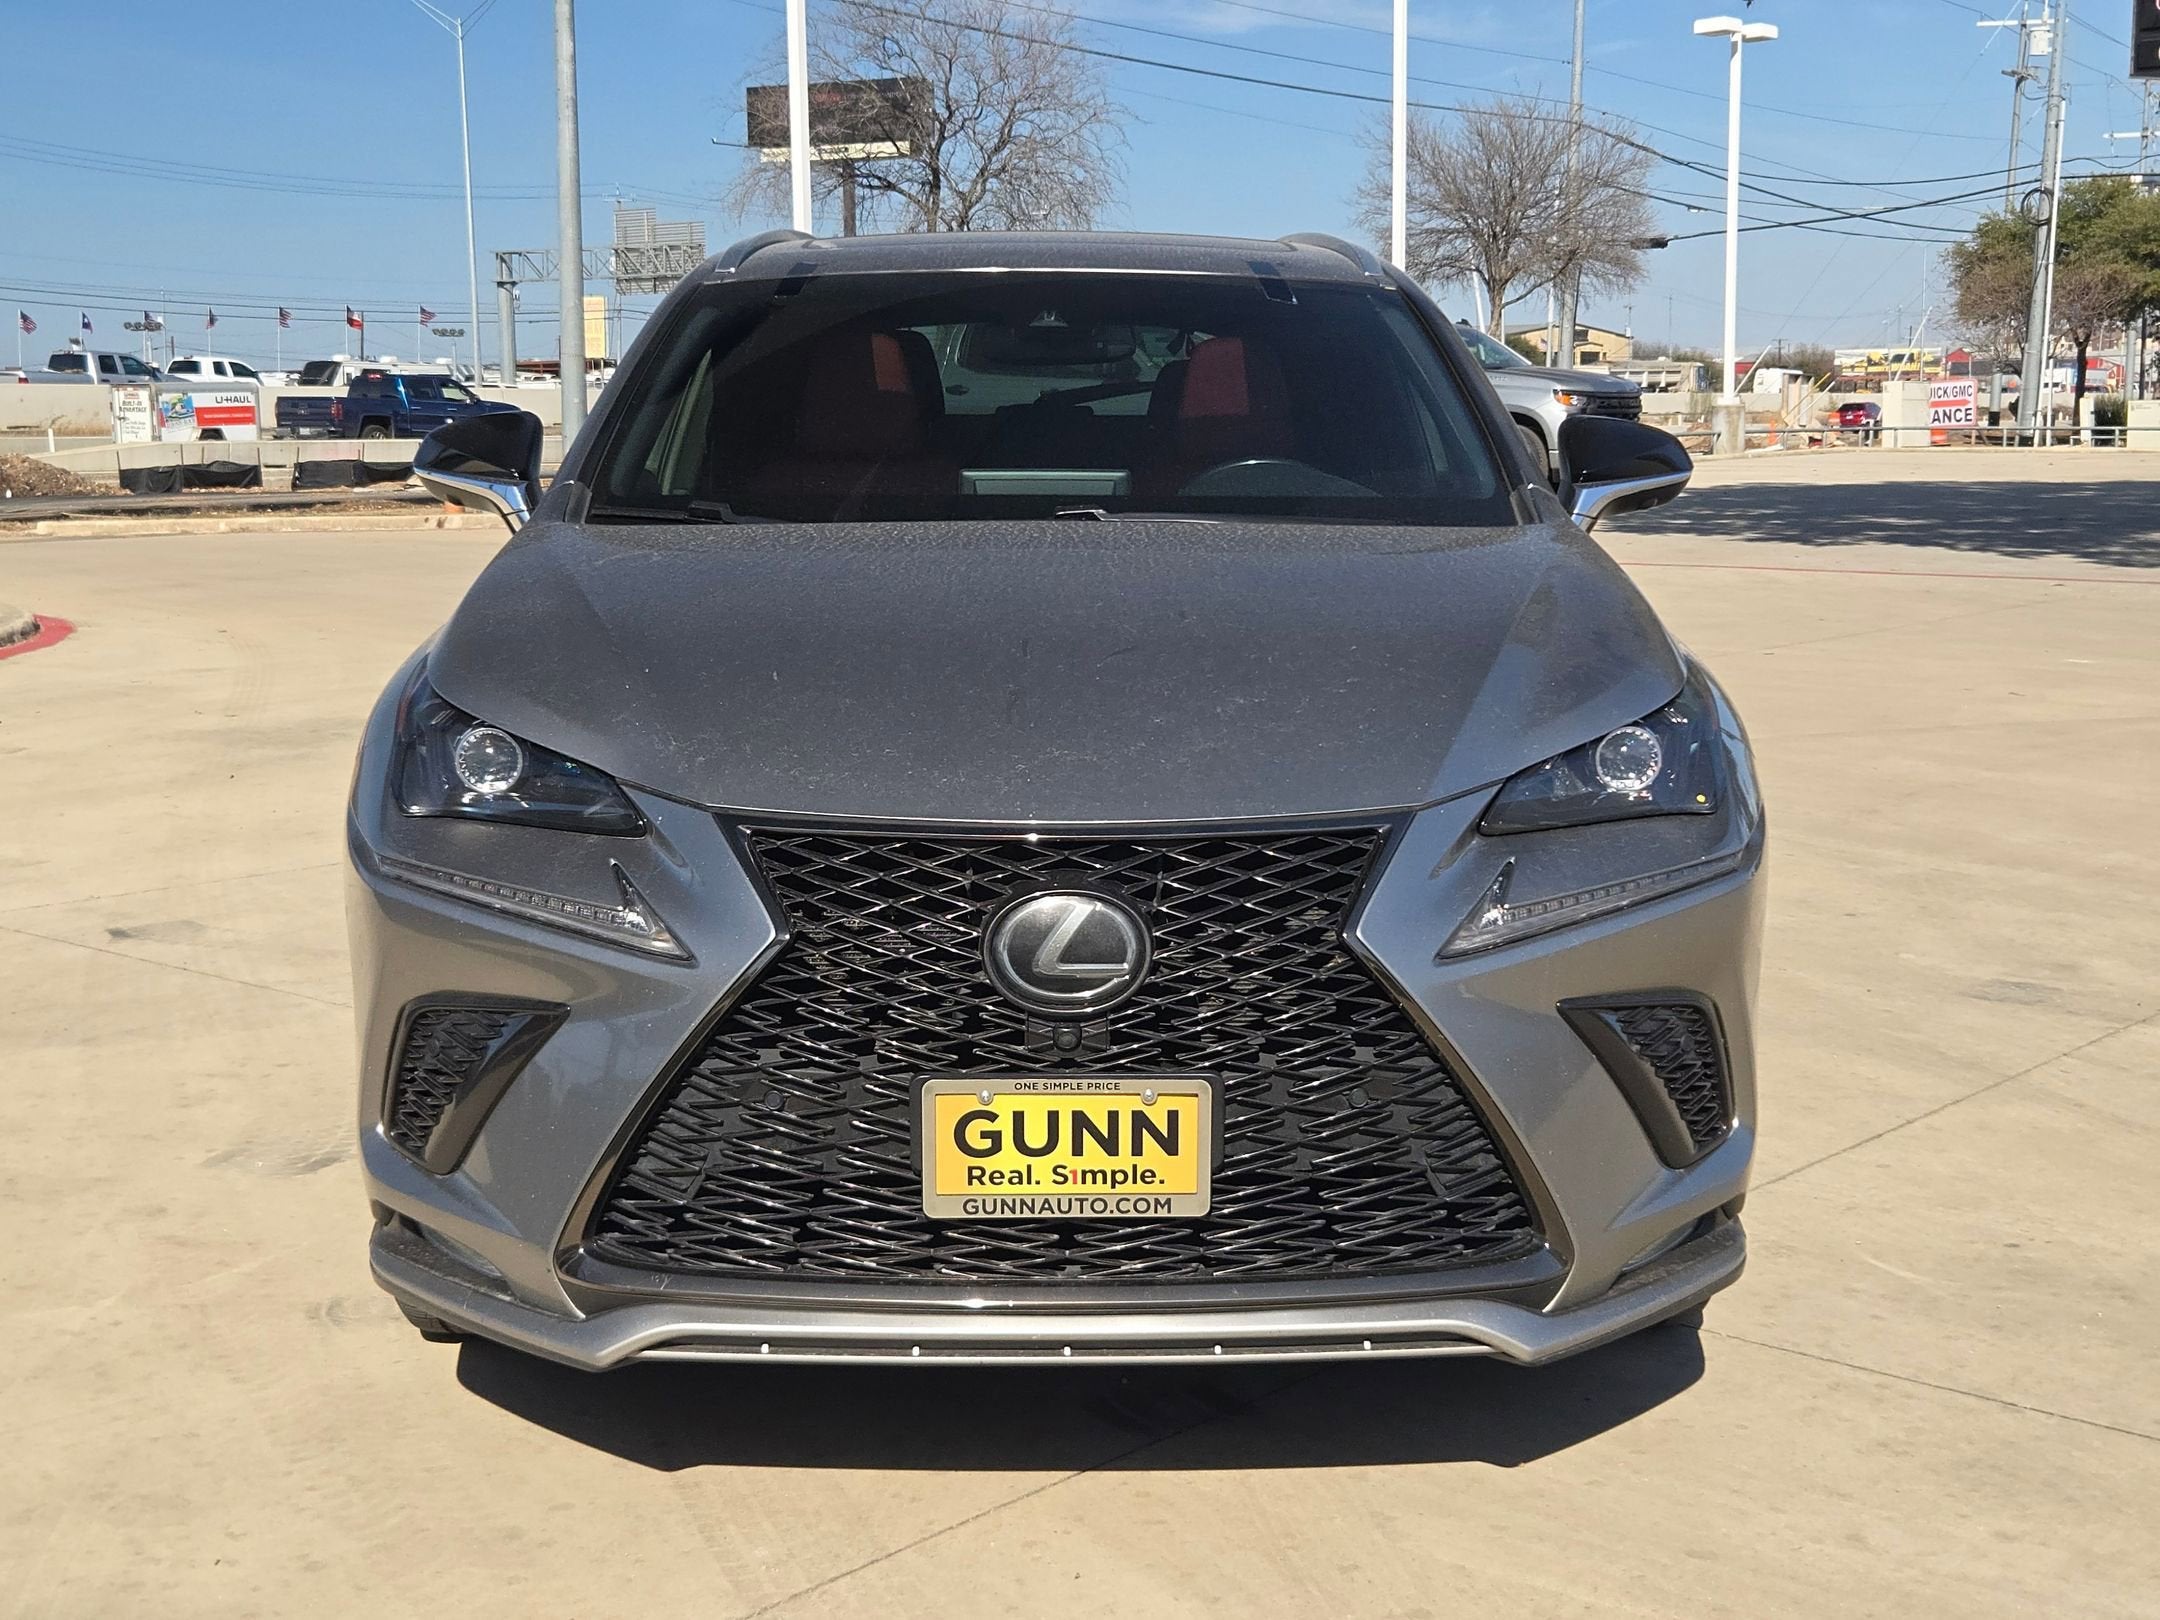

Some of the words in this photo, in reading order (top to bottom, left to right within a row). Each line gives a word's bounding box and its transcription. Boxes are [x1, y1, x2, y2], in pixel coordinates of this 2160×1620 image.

[215, 396, 251, 404] U-HAUL
[1014, 1082, 1039, 1091] ONE
[1042, 1082, 1084, 1091] SIMPLE
[1087, 1082, 1121, 1091] PRICE
[953, 1109, 1179, 1158] GUNN
[967, 1164, 1041, 1186] Real.
[962, 1197, 1172, 1215] GUNNAUTO.COM
